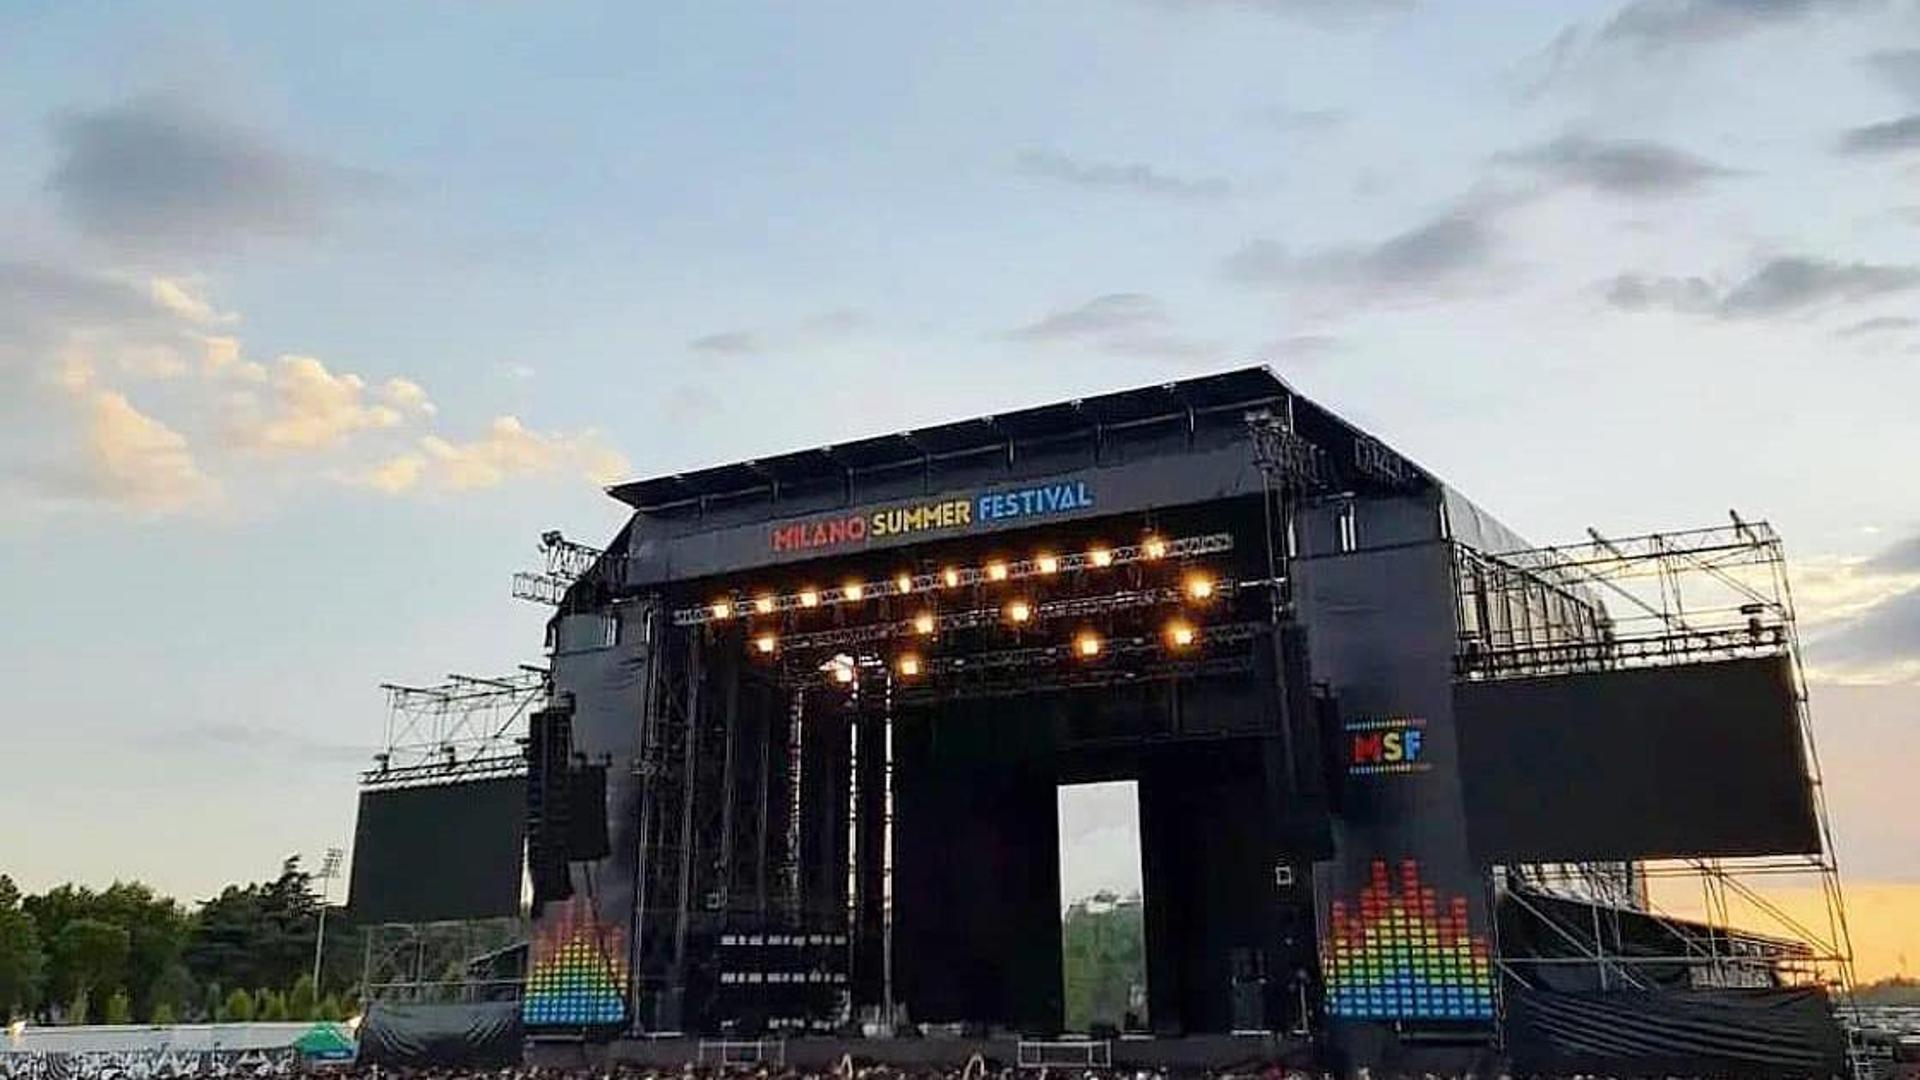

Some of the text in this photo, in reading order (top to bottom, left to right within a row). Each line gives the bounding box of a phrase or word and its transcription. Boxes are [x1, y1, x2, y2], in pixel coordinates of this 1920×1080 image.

[773, 482, 1093, 550] MILANO SUMMER FESTIVAL
[1354, 730, 1421, 762] MSF
